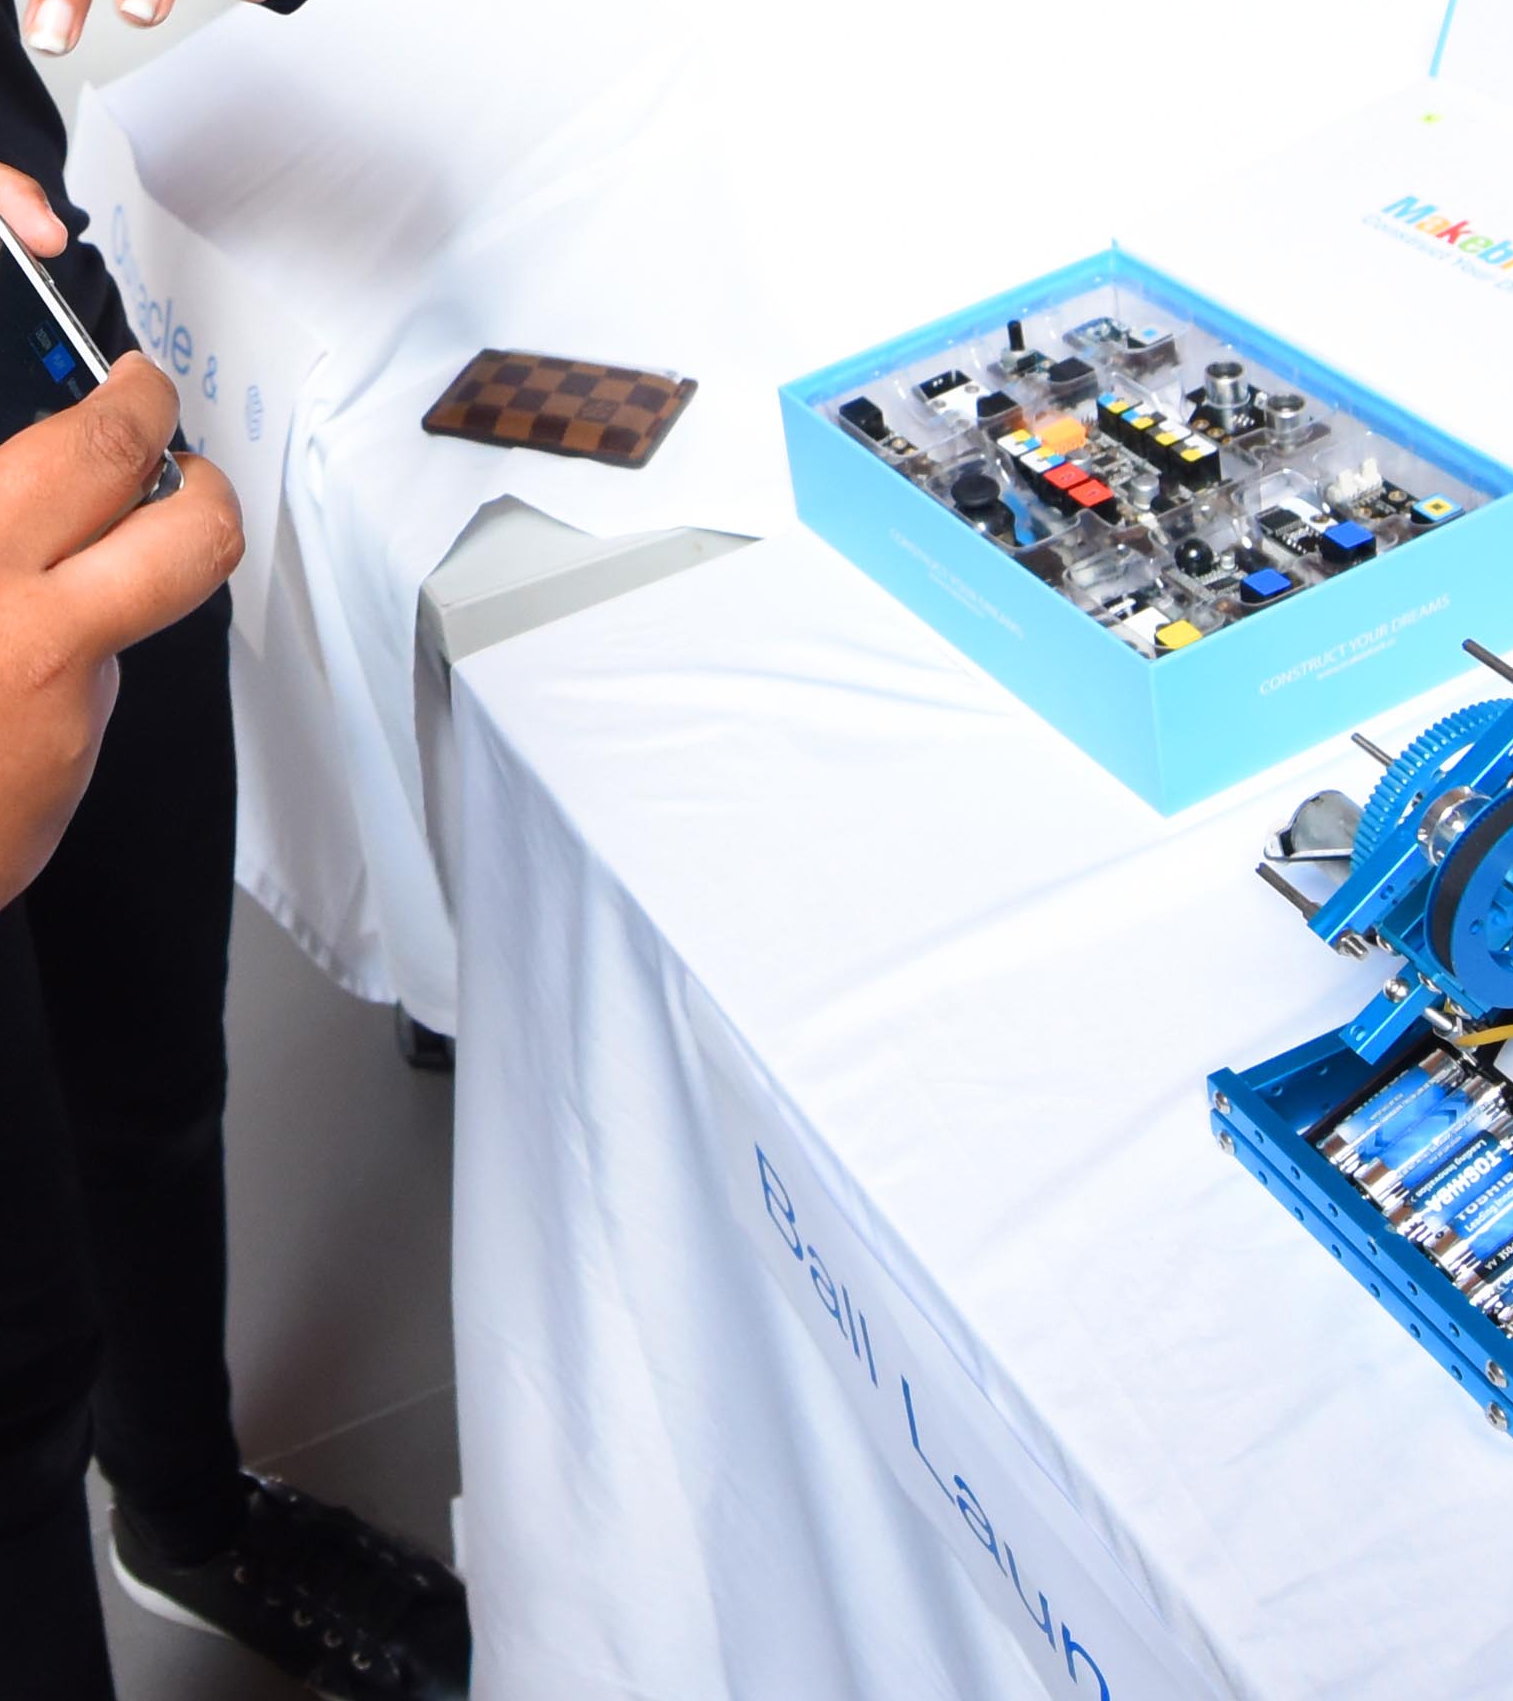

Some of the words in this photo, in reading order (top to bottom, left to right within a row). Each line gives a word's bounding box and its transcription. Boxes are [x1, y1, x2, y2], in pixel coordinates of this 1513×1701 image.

[1259, 643, 1349, 696] CONSTRUCT
[1348, 623, 1390, 653] YOUR
[1391, 593, 1451, 633] DREAMS
[1454, 1138, 1488, 1167] Leading
[1415, 1162, 1459, 1198] Innovation
[1425, 1149, 1503, 1213] TOSHIBA
[1464, 1200, 1500, 1233] Leading
[754, 1140, 879, 1389] Ball
[1484, 1256, 1498, 1272] AA
